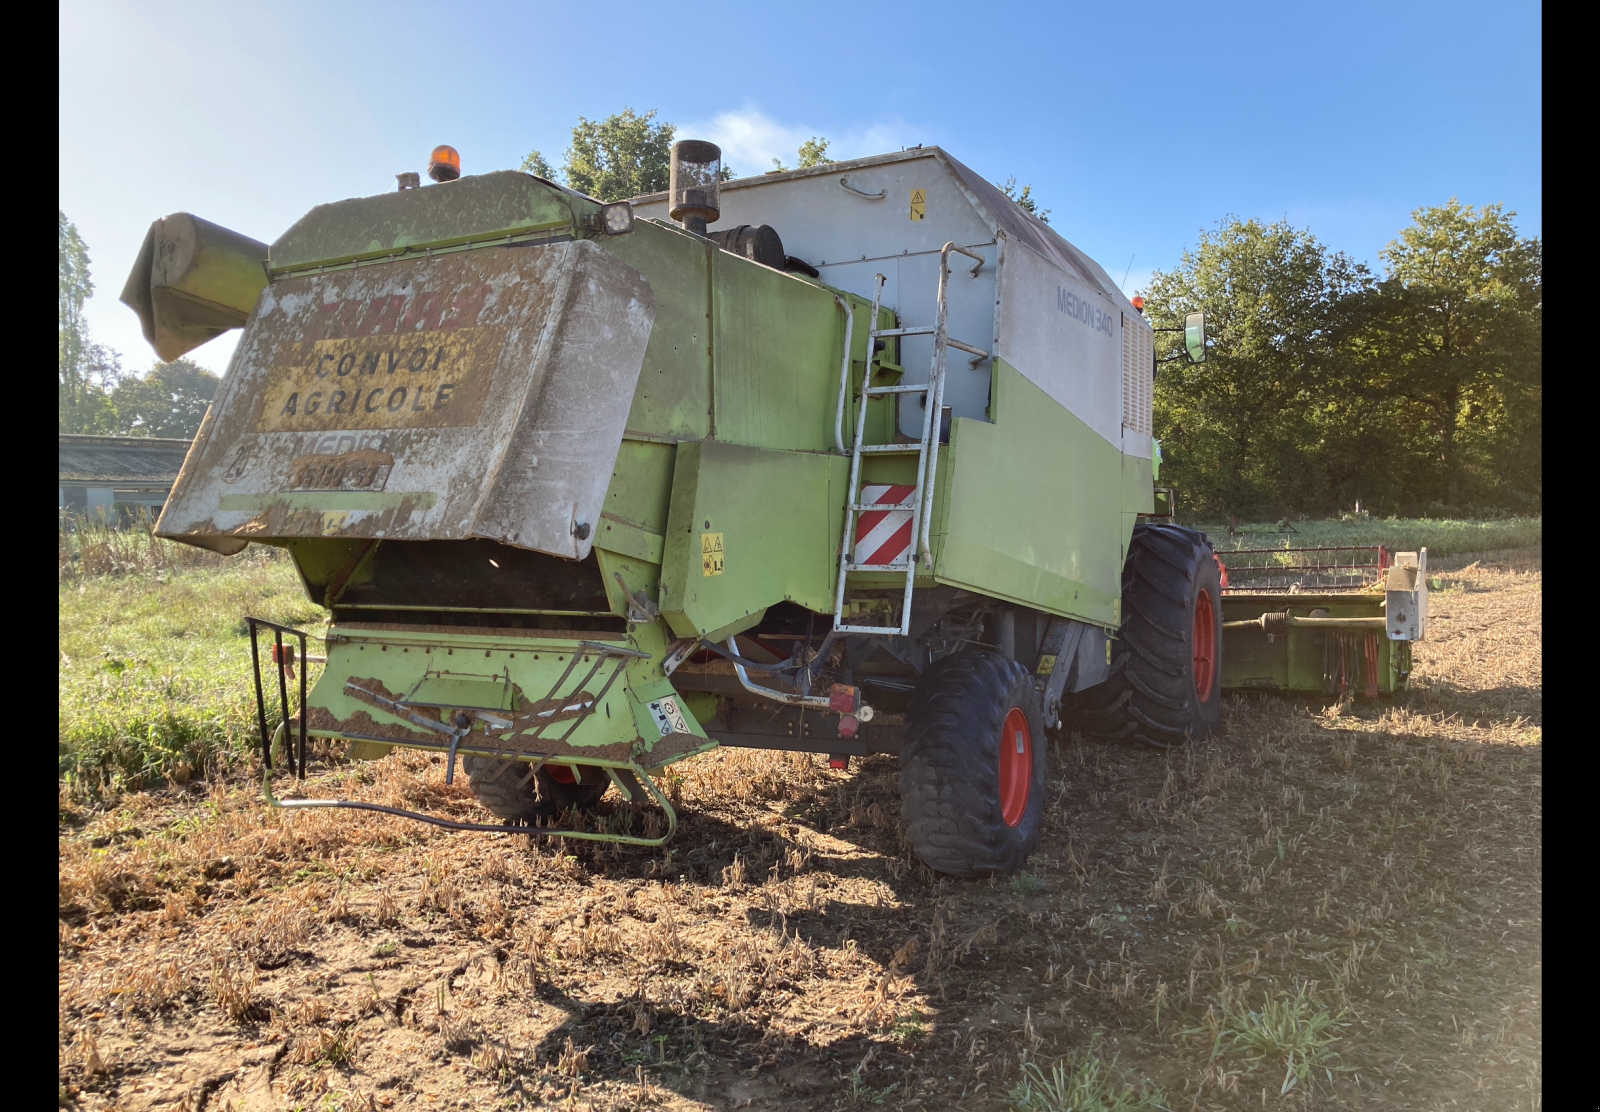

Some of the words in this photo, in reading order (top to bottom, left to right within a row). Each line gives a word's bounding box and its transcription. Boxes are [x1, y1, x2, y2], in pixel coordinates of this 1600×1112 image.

[1057, 286, 1095, 329] MEDION
[1096, 308, 1113, 338] 340
[315, 345, 444, 378] CONVOI
[279, 383, 456, 416] AGRICOLE
